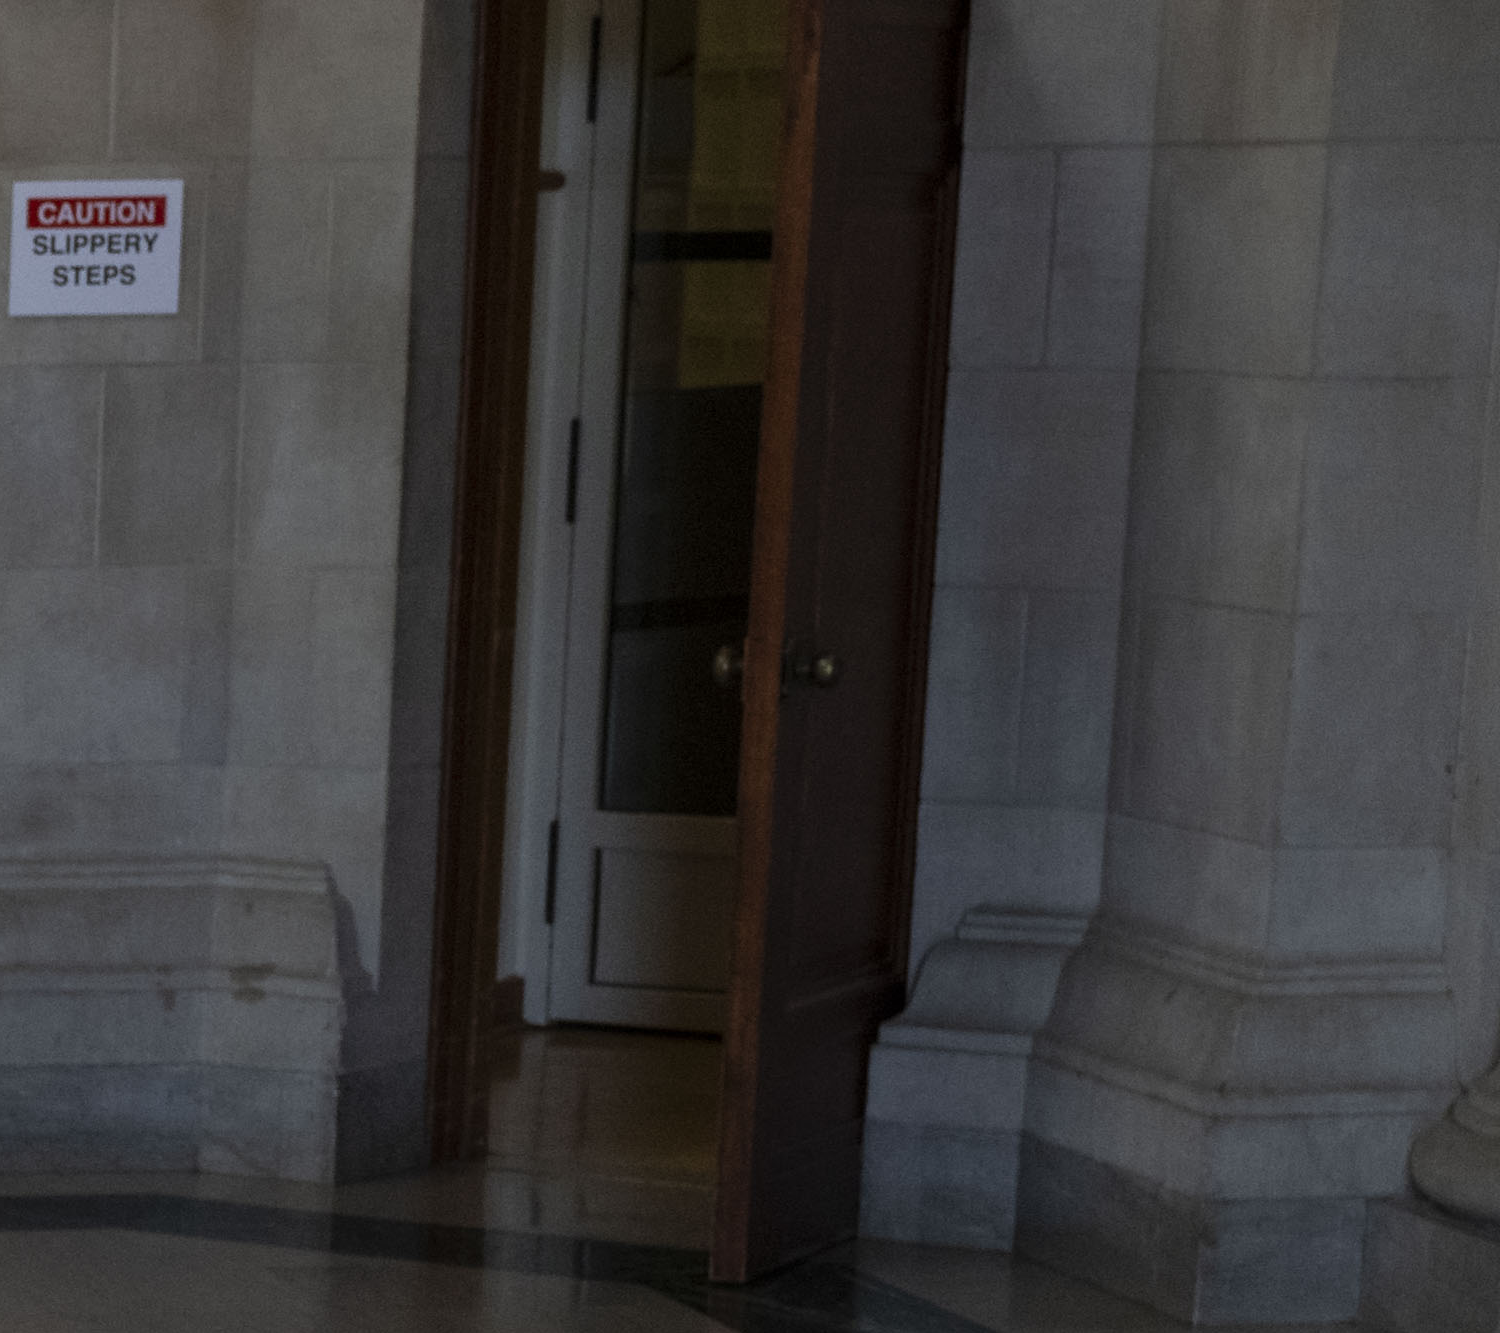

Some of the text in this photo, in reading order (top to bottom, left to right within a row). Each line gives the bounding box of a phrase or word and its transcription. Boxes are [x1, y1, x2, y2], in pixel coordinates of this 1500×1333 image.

[38, 201, 156, 225] CAUTION
[32, 234, 159, 255] SLIPPERY
[53, 265, 136, 286] STEPS
